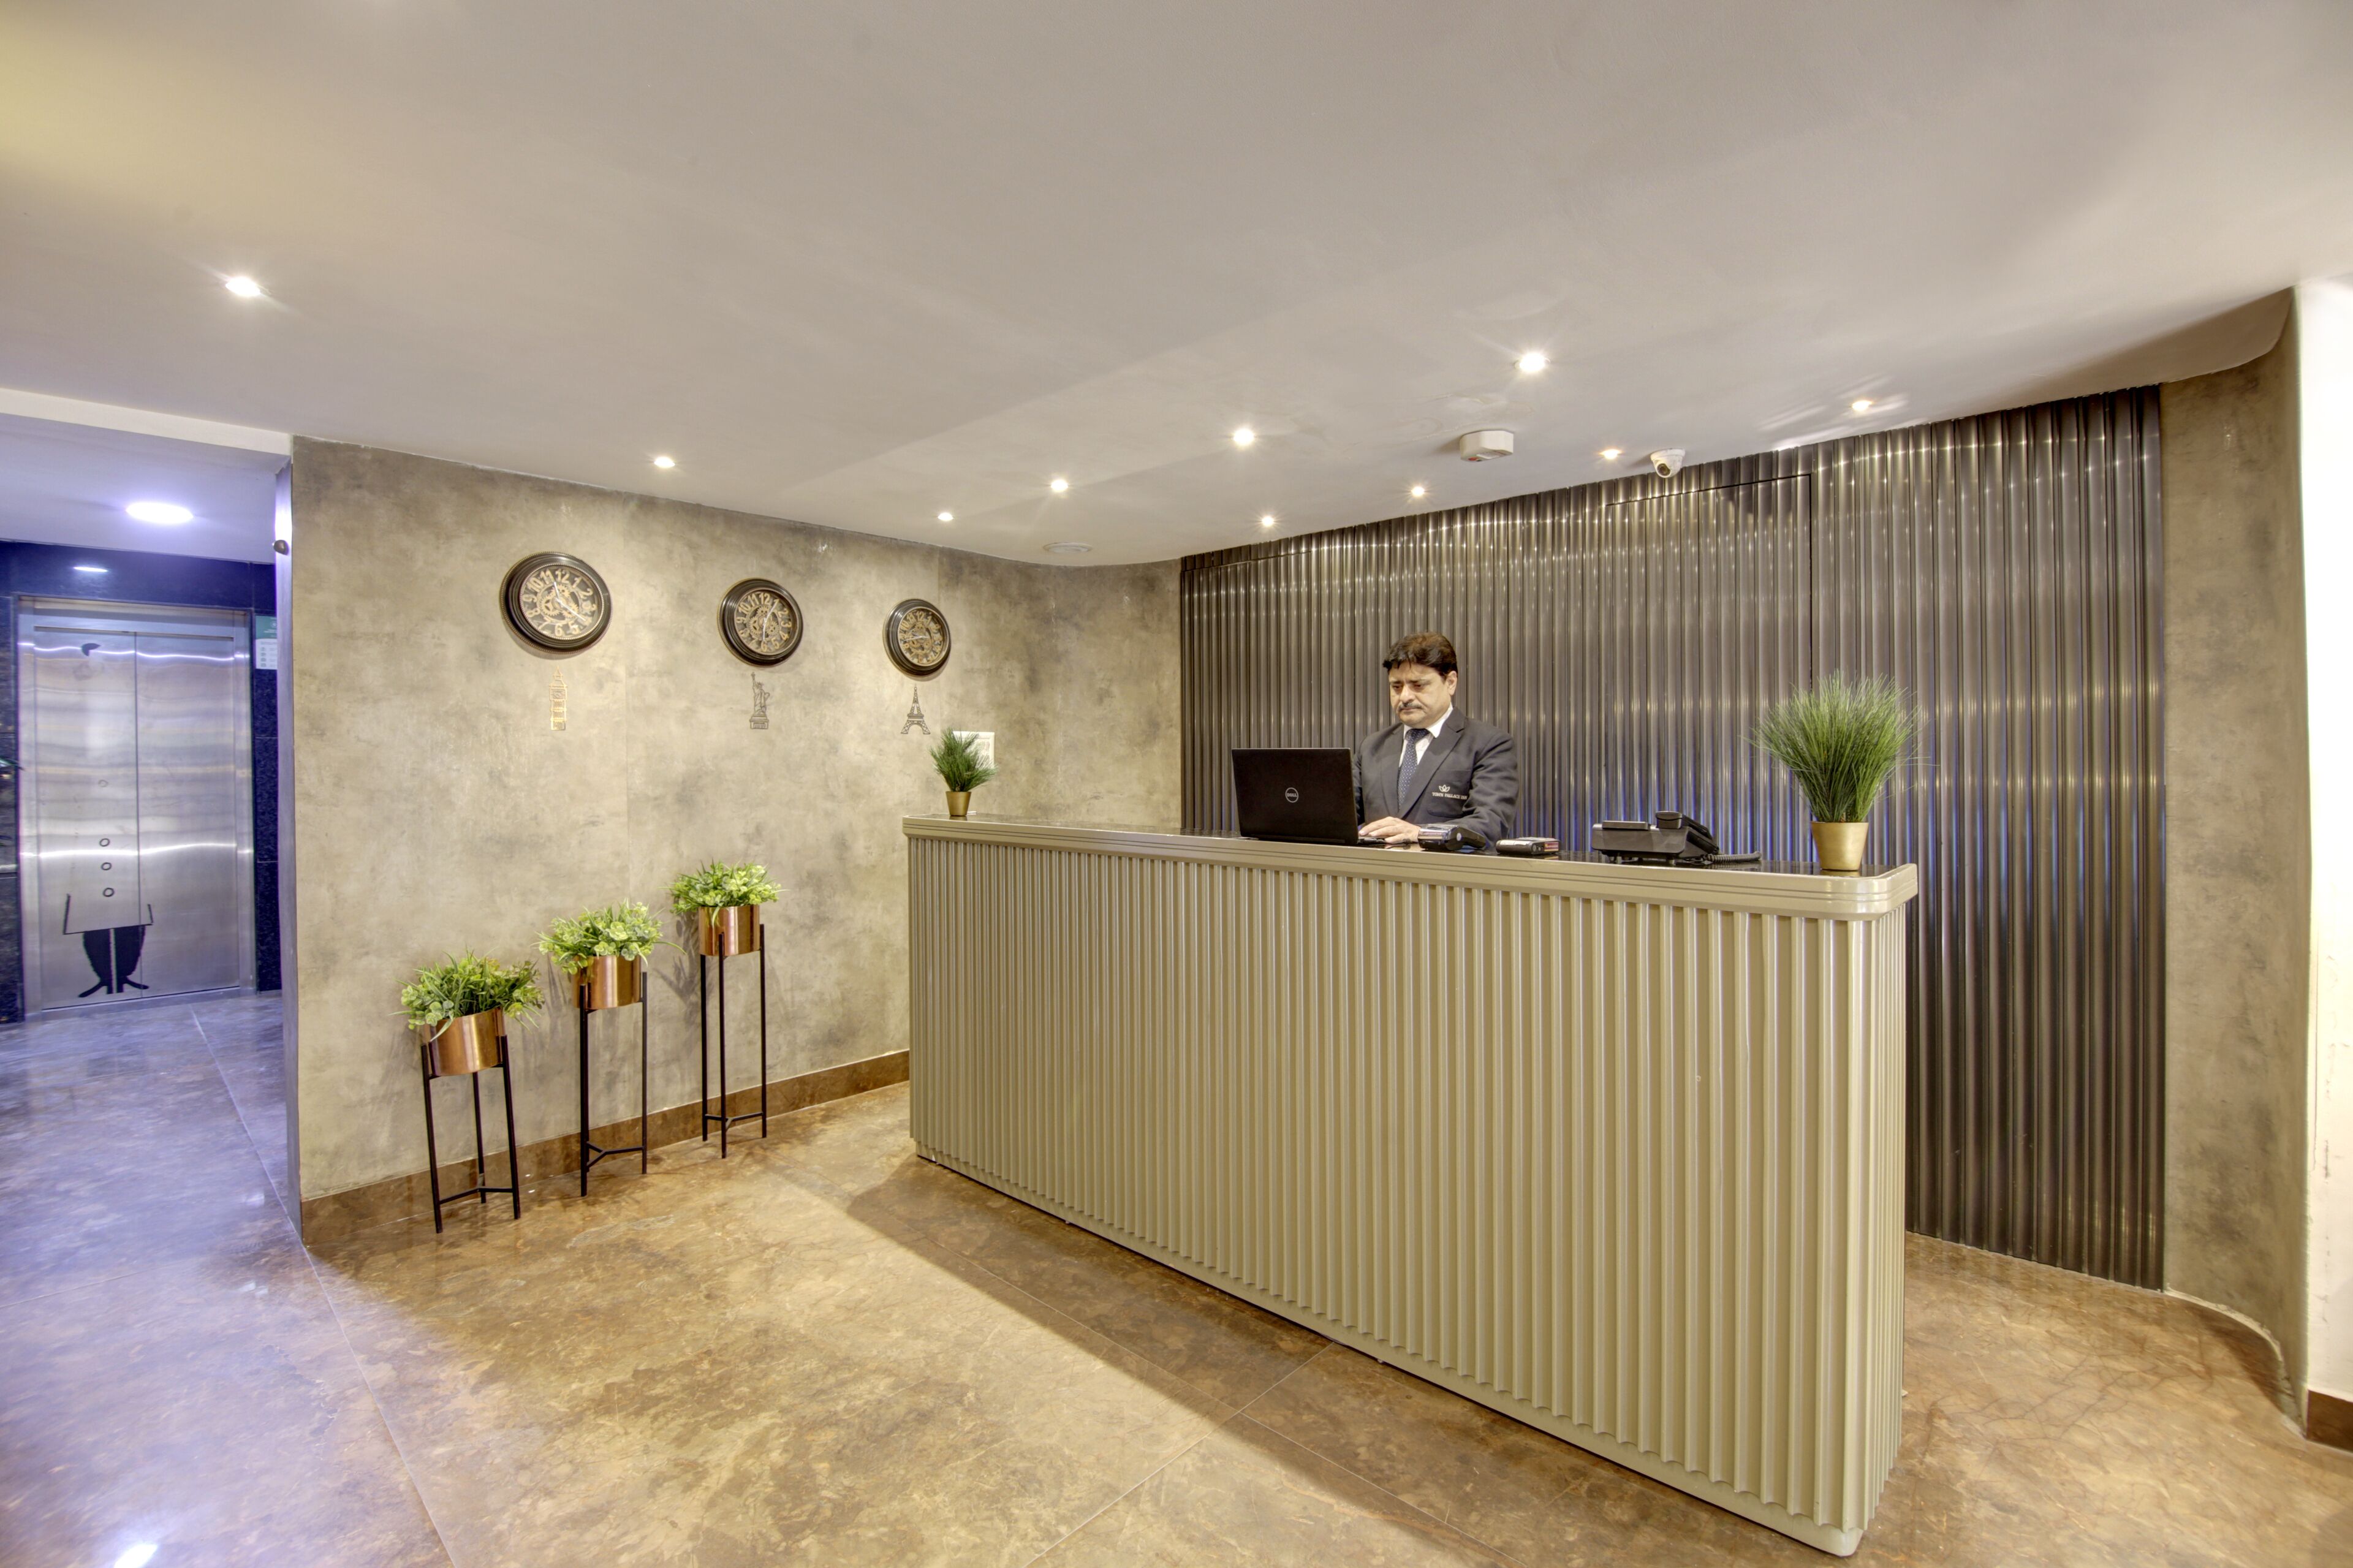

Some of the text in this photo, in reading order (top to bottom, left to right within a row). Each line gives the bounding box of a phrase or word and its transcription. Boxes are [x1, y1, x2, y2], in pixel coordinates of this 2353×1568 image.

[540, 569, 555, 584] 11
[555, 569, 570, 584] 12
[572, 577, 582, 588] 1
[527, 577, 544, 592] 10
[580, 588, 593, 599] 2
[759, 593, 771, 605] 12
[748, 594, 759, 607] 11
[526, 608, 540, 618] 8
[738, 602, 751, 615] 10
[778, 608, 789, 618] 2
[907, 613, 917, 623] 11
[917, 611, 924, 621] 12
[927, 616, 931, 625] 1
[555, 623, 563, 637] 6
[569, 621, 580, 635] 5
[900, 620, 909, 630] 10
[779, 631, 789, 640] 4
[761, 640, 767, 652] 6
[771, 637, 779, 650] 5
